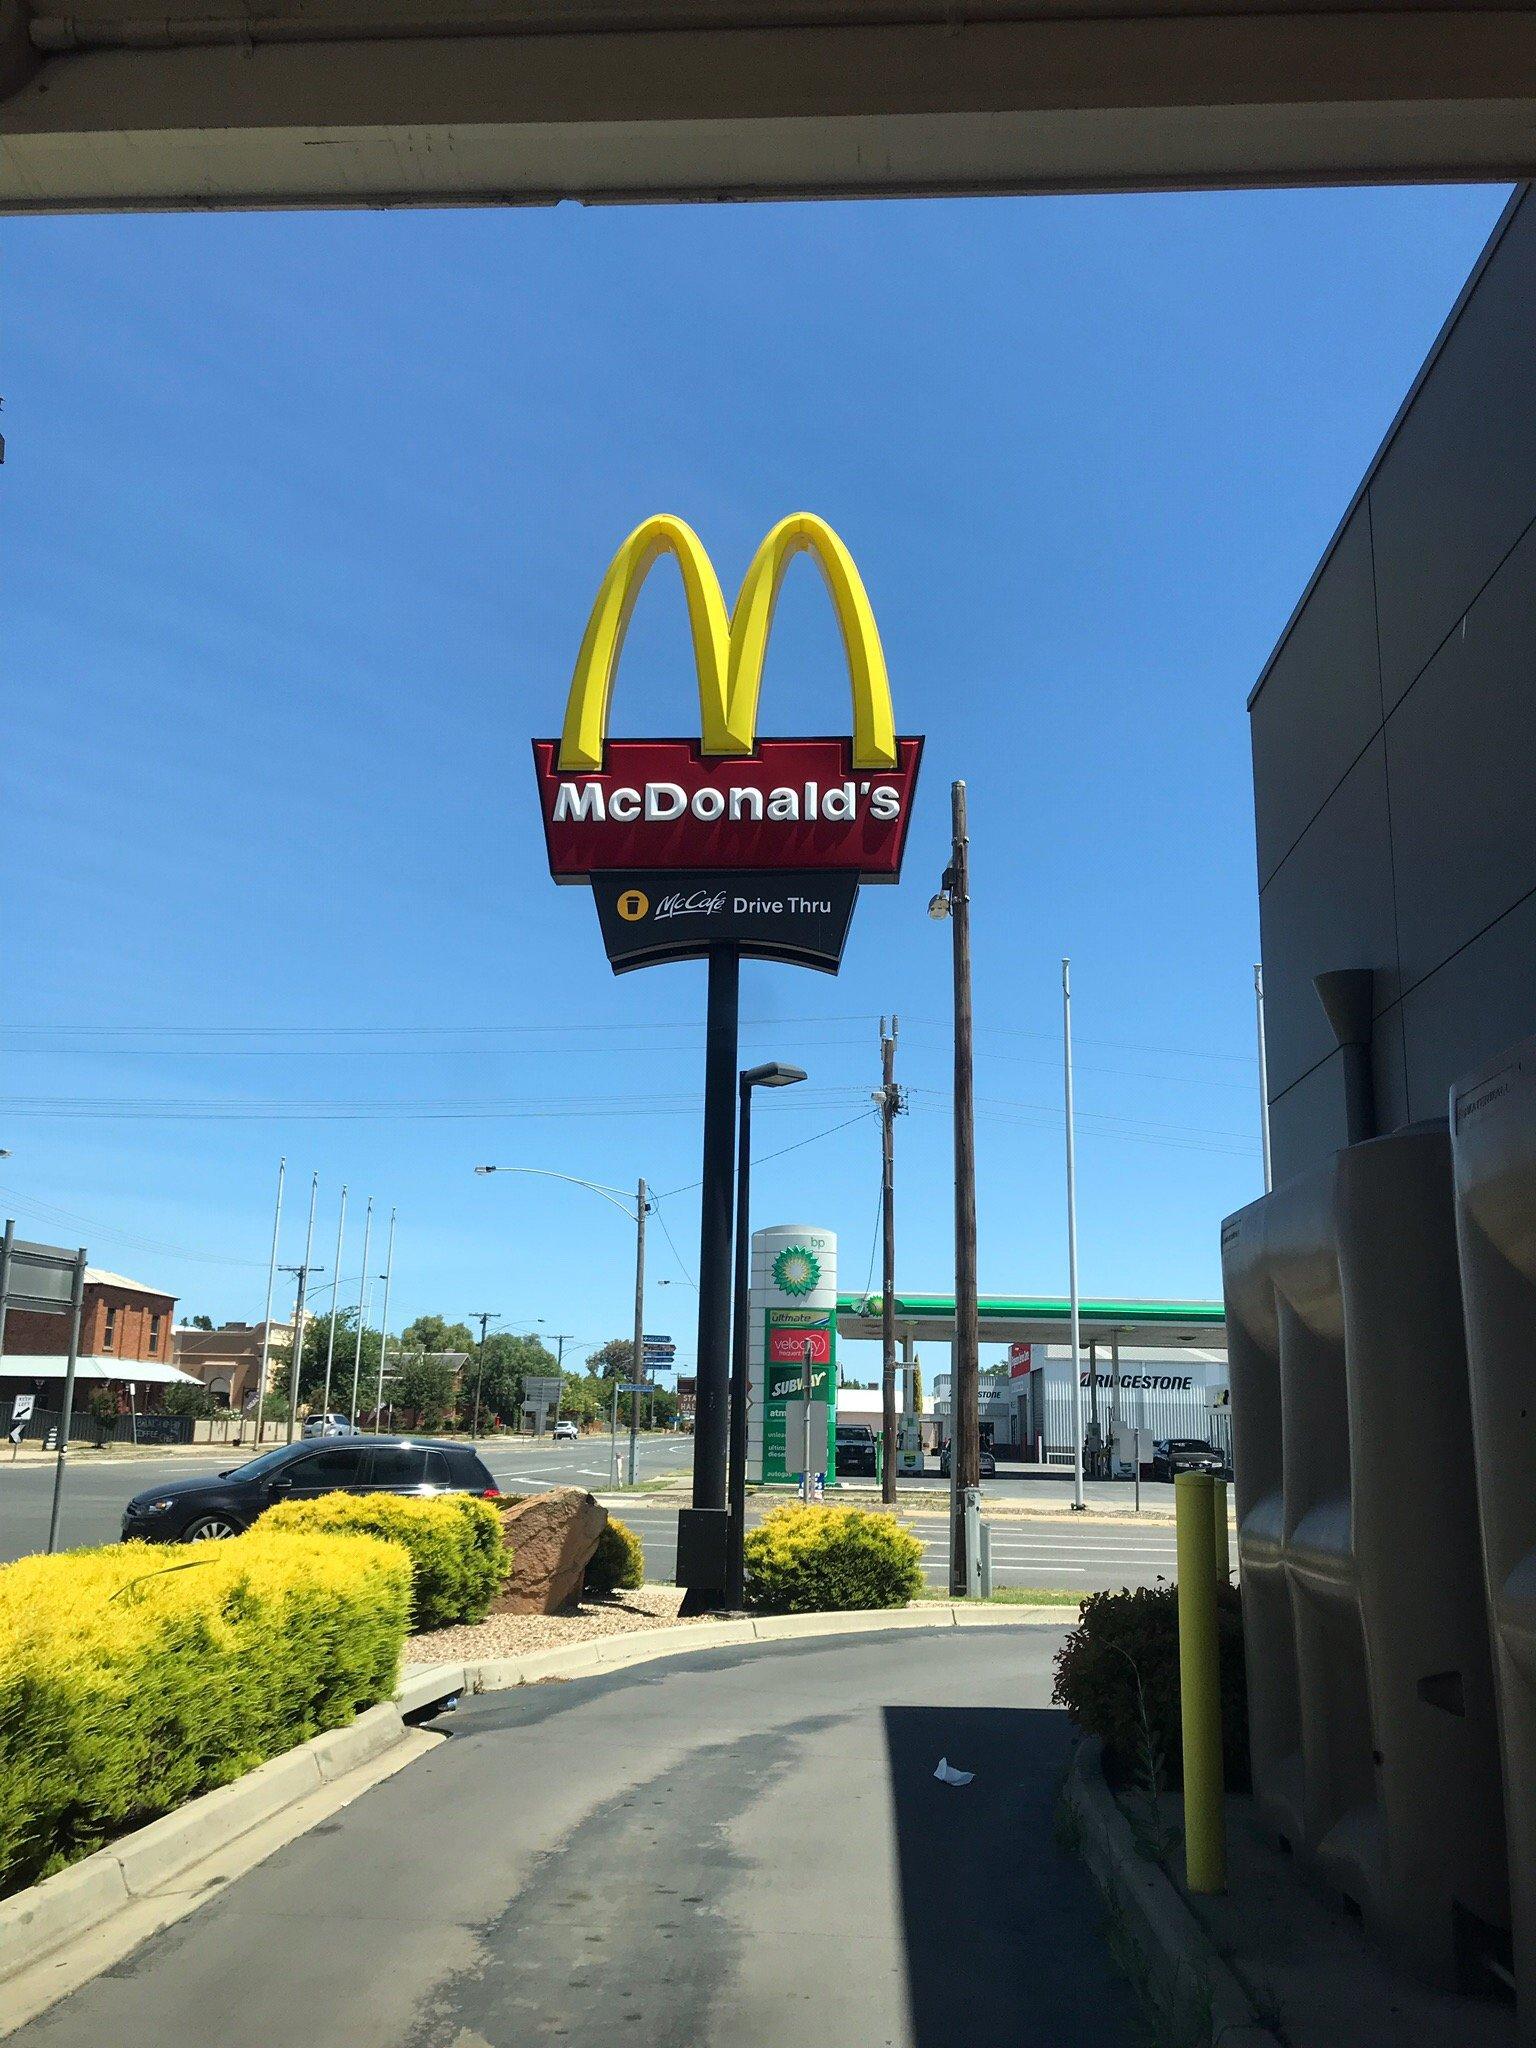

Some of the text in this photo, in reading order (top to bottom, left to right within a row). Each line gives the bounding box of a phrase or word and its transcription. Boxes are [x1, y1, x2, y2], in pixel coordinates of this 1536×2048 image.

[552, 781, 902, 822] McDonald's
[653, 889, 832, 921] McCafé Drive Thru
[810, 1236, 826, 1250] bp
[774, 1335, 824, 1356] velocy
[1080, 1372, 1193, 1390] BRIGESTONE
